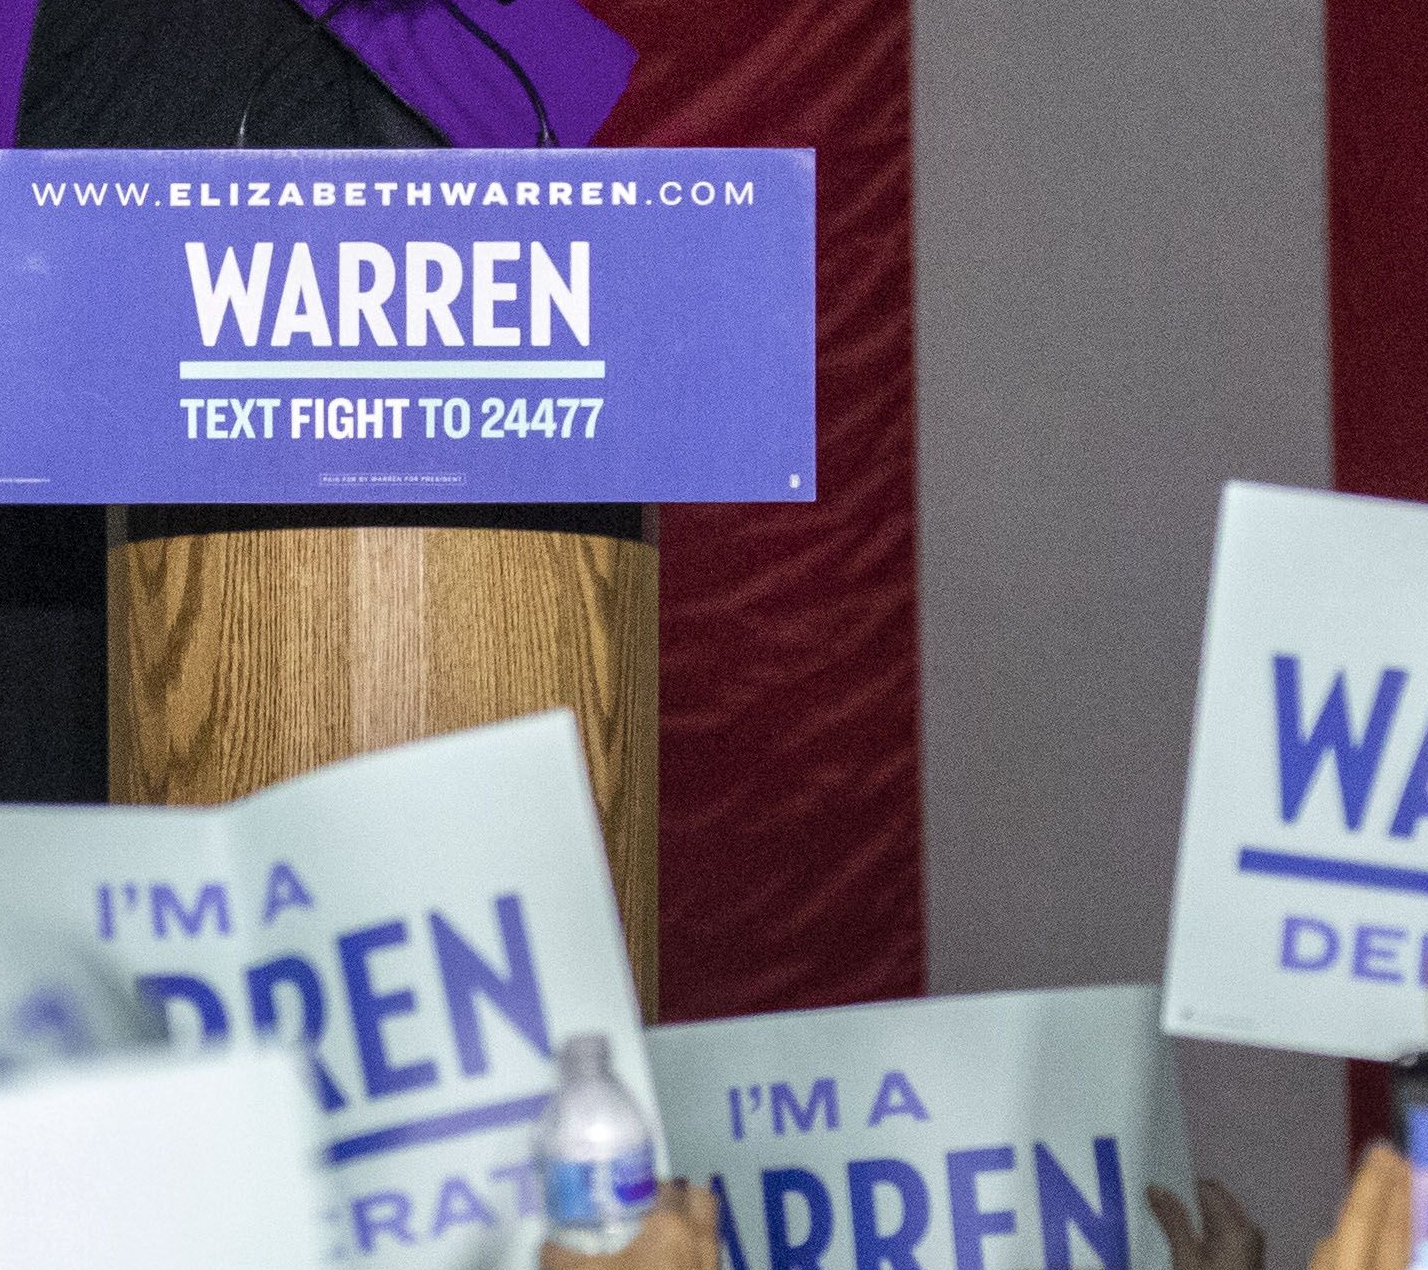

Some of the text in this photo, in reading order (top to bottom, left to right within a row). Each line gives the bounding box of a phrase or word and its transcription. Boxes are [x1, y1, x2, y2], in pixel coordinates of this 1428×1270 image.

[31, 180, 755, 208] WWW.ELIZABETHWARREN.COM
[184, 240, 591, 348] WARREN
[180, 397, 605, 439] TEXT FIGHT TO 24477
[96, 859, 316, 942] I'M A
[727, 1070, 930, 1141] I'M A
